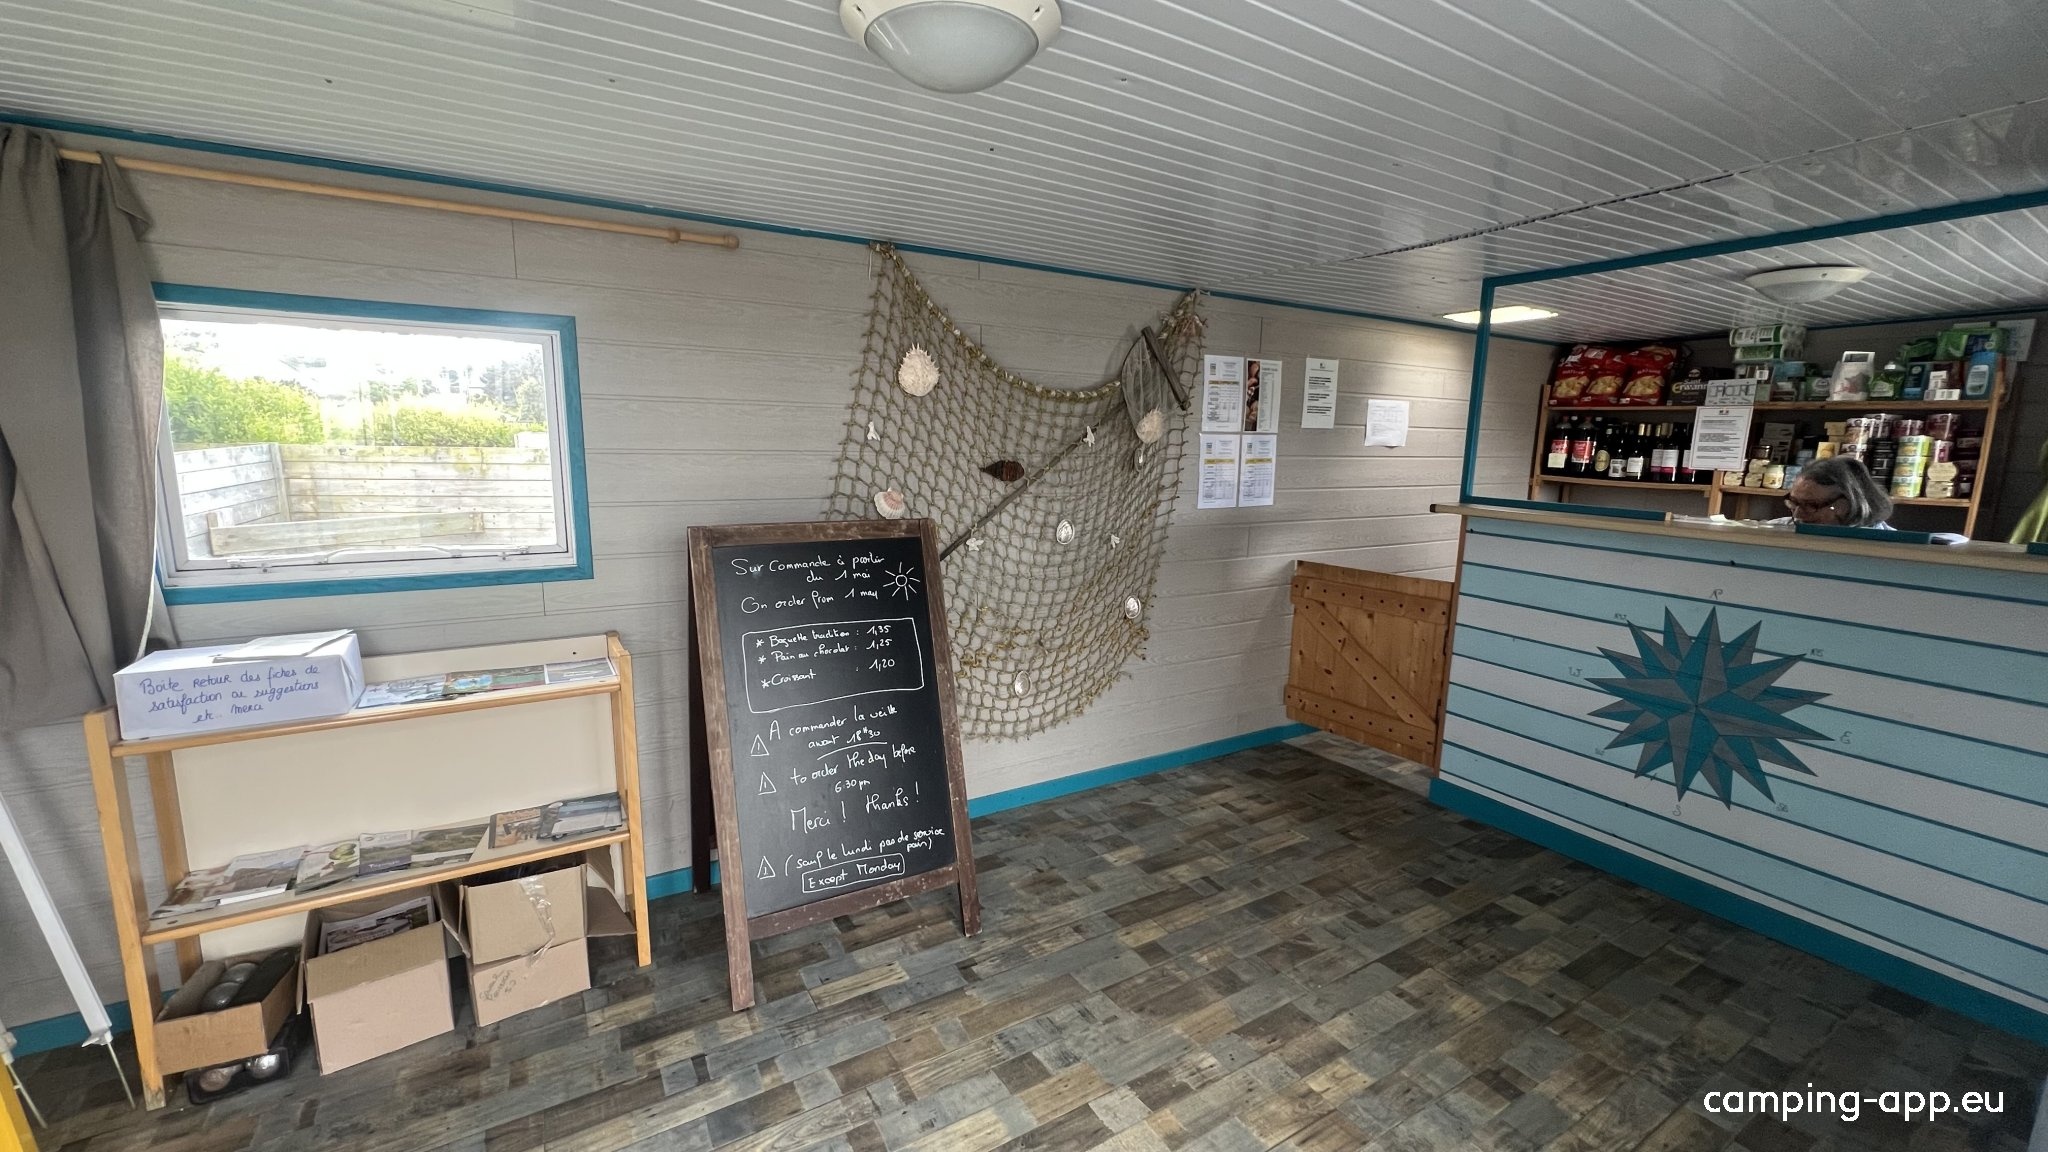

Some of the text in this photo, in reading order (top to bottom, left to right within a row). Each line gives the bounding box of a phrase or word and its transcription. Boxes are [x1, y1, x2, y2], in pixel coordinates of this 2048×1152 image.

[731, 558, 764, 575] Sur
[837, 554, 845, 566] à
[852, 552, 885, 569] partir
[807, 569, 871, 582] du 1 mai
[741, 597, 767, 614] On
[775, 597, 805, 609] order
[811, 590, 834, 610] from
[845, 588, 854, 598] 1
[769, 631, 808, 648] Baguette
[812, 628, 850, 641] tradition
[867, 624, 891, 636] 1,35
[770, 649, 795, 662] Pain
[798, 651, 809, 660] au
[814, 644, 850, 658] chocolat
[866, 638, 892, 650] 1,25
[240, 670, 261, 682] des
[267, 665, 299, 687] fiches
[305, 664, 320, 674] de
[772, 668, 816, 685] Croissant
[869, 658, 895, 672] 1,20
[149, 692, 222, 715] satisfaction
[254, 680, 319, 702] suggestions
[769, 704, 897, 741] A commander la veille
[808, 735, 839, 749] avant
[790, 744, 916, 784] to order the day before
[790, 808, 830, 834] Merci
[827, 848, 837, 861] le
[840, 842, 873, 859] lundi
[879, 837, 894, 853] pas
[894, 830, 909, 844] de
[913, 827, 945, 841] service
[807, 858, 901, 890] Except Monday
